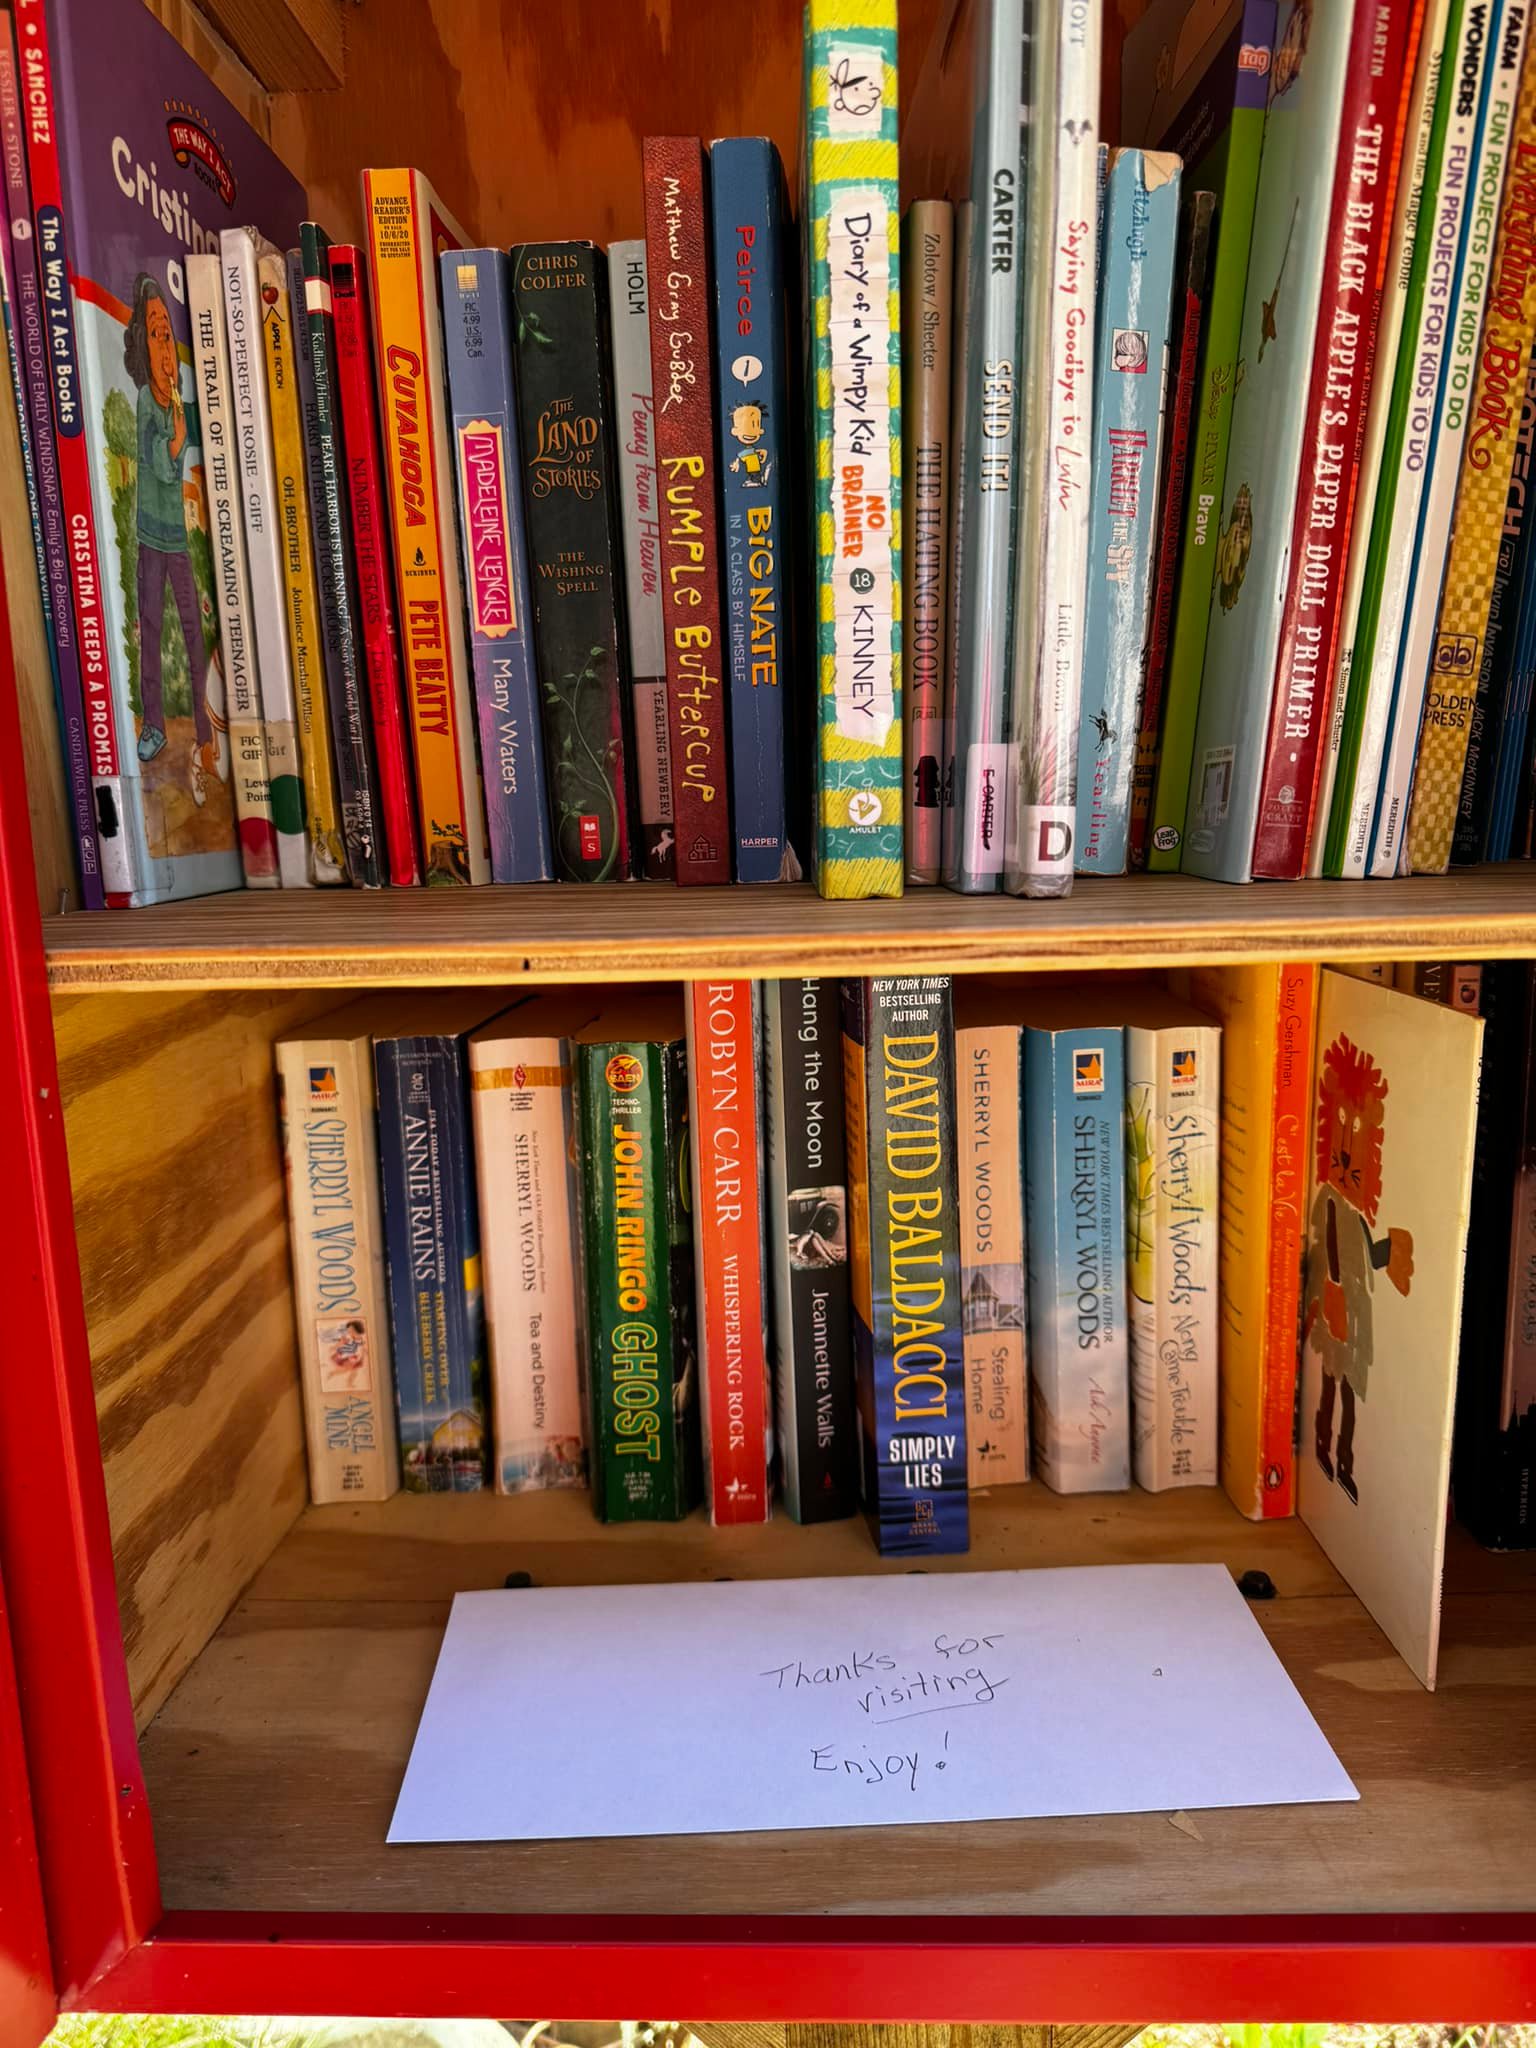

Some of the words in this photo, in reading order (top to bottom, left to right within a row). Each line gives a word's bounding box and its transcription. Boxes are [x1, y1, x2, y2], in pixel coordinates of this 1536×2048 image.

[1371, 6, 1392, 79] MARTIN
[1457, 3, 1489, 119] WONDERS
[1500, 5, 1526, 72] FARM
[25, 48, 51, 145] SANCHEZ
[1488, 99, 1510, 138] FUN
[1350, 123, 1385, 187] THE
[1446, 143, 1468, 189] FUN
[374, 206, 411, 216] READER'S
[375, 196, 410, 207] ADVANCE
[378, 215, 408, 225] EDITION
[992, 168, 1016, 276] CARTER
[1472, 151, 1503, 256] PROJECTS
[41, 217, 59, 252] The
[380, 230, 409, 240] 10/6/20
[844, 212, 873, 288] Diary
[1058, 219, 1090, 296] Saying
[1337, 199, 1375, 293] BLACK
[1428, 190, 1462, 298] PROJECTS
[45, 259, 63, 302] Way
[520, 274, 588, 293] COLFER
[527, 254, 579, 272] CHRIS
[626, 261, 646, 316] HOLM
[736, 225, 757, 337] Peirce
[922, 233, 941, 298] Zolotow
[1469, 259, 1488, 303] FOR
[23, 302, 41, 356] WORLD
[198, 310, 215, 350] THE
[463, 315, 481, 326] 4.99
[464, 302, 478, 314] FIC
[1422, 302, 1445, 348] FOR
[1454, 306, 1479, 357] KIDS
[52, 318, 70, 358] Act
[269, 322, 282, 353] APPLE
[465, 336, 483, 348] 6.99
[466, 348, 485, 359] Can.
[923, 312, 942, 372] Shecter
[28, 357, 44, 379] OF
[56, 364, 75, 425] Books
[201, 356, 219, 415] TRAIL
[227, 265, 252, 418] NOT-SO-PERFECT
[242, 425, 258, 477] ROSIE
[848, 333, 873, 414] Wimpy
[1322, 306, 1362, 428] APPLE'S
[1449, 359, 1470, 393] TO
[32, 381, 50, 426] EMILY
[626, 391, 653, 455] Penny
[983, 360, 1013, 439] SEND
[1444, 395, 1465, 431] DO
[209, 421, 225, 446] OF
[321, 434, 335, 478] PEARL
[387, 344, 428, 528] CUYAHOGA
[528, 410, 599, 468] LAND
[849, 418, 877, 456] Kid
[1405, 440, 1425, 473] DO
[212, 452, 229, 491] THE
[283, 476, 296, 503] OH,
[466, 434, 502, 551] MADELEINE
[531, 467, 602, 501] STORIES
[917, 442, 943, 499] THE
[1107, 428, 1149, 516] HARRIET
[1309, 442, 1345, 532] PAPER
[325, 478, 340, 537] HARBOR
[729, 514, 742, 529] IN
[842, 464, 865, 559] BRAINER
[864, 494, 887, 531] NO
[1193, 494, 1214, 546] Brave
[71, 514, 97, 610] CRISTINA
[217, 499, 240, 607] SCREAMING
[284, 505, 302, 574] BROTHER
[330, 538, 342, 551] IS
[557, 551, 586, 563] THE
[636, 513, 659, 598] Heaven
[730, 535, 742, 548] A
[914, 507, 943, 616] HATING
[476, 556, 508, 625] L'ENGLE
[537, 563, 604, 581] WISHING
[556, 580, 600, 598] SPELL
[730, 554, 744, 597] CLASS
[1299, 543, 1334, 614] DOLL
[408, 600, 442, 650] PETE
[732, 601, 745, 616] BY
[1057, 602, 1074, 657] Little,
[81, 616, 105, 673] KEEPS
[228, 614, 250, 711] TEENAGER
[733, 620, 747, 683] HIMSELF
[750, 586, 779, 688] NATE
[852, 604, 876, 719] KINNEY
[912, 622, 940, 692] BOOK
[345, 679, 358, 710] World
[413, 657, 450, 737] BEATTY
[489, 658, 512, 714] Many
[1053, 659, 1073, 714] Brown
[1284, 627, 1322, 741] PRIMER
[1335, 696, 1347, 713] and
[1338, 666, 1351, 695] Simon
[241, 736, 262, 747] FIC
[300, 696, 313, 735] Wilson
[349, 712, 361, 734] War
[652, 690, 670, 752] YEARLING
[499, 719, 519, 795] Waters
[78, 794, 92, 833] PRESS
[656, 755, 672, 818] NEWBERY
[1084, 757, 1113, 858] Yearling
[741, 837, 779, 847] HARPER
[848, 826, 883, 835] AMULET
[1037, 820, 1073, 863] D
[797, 977, 821, 1042] Hang
[872, 979, 895, 993] NEW
[895, 978, 920, 991] YORK
[921, 976, 950, 990] TIMES
[879, 992, 942, 1008] BESTSELLING
[892, 1009, 929, 1023] AUTHOR
[708, 983, 739, 1112] ROBYN
[804, 1050, 823, 1091] the
[883, 1030, 942, 1180] DAVID
[973, 1048, 991, 1153] SHERRYL
[404, 1114, 431, 1199] ANNIE
[805, 1101, 824, 1169] Moon
[1100, 1119, 1111, 1146] NEW
[303, 1119, 355, 1217] SHERRYL
[613, 1124, 645, 1210] JOHN
[712, 1127, 743, 1227] CARR
[1070, 1115, 1096, 1241] SHERRYL
[1100, 1152, 1111, 1181] YORK
[1161, 1114, 1207, 1213] Sherryl
[975, 1161, 993, 1254] WOODS
[1100, 1182, 1112, 1215] TIMES
[312, 1222, 362, 1313] WOODS
[410, 1206, 437, 1281] RAINS
[616, 1216, 649, 1313] RINGO
[1168, 1216, 1208, 1306] Woods
[722, 1253, 744, 1386] WHISPERING
[887, 1186, 949, 1422] BALDACCI
[1076, 1242, 1100, 1351] WOODS
[1103, 1294, 1114, 1344] AUTHOR
[529, 1312, 542, 1339] Tea
[811, 1288, 832, 1390] Jeannette
[531, 1342, 544, 1370] and
[989, 1345, 1011, 1422] Stealing
[532, 1376, 548, 1430] Destiny
[611, 1321, 661, 1462] GHOST
[970, 1357, 987, 1415] Home
[727, 1391, 746, 1450] ROCK
[816, 1393, 836, 1449] Walls
[888, 1434, 957, 1464] SIMPLY
[904, 1462, 943, 1490] LIES
[759, 1651, 897, 1689] Thanks
[934, 1633, 1005, 1660] for
[857, 1668, 1010, 1713] visiting
[810, 1730, 950, 1792] Enjoy!
